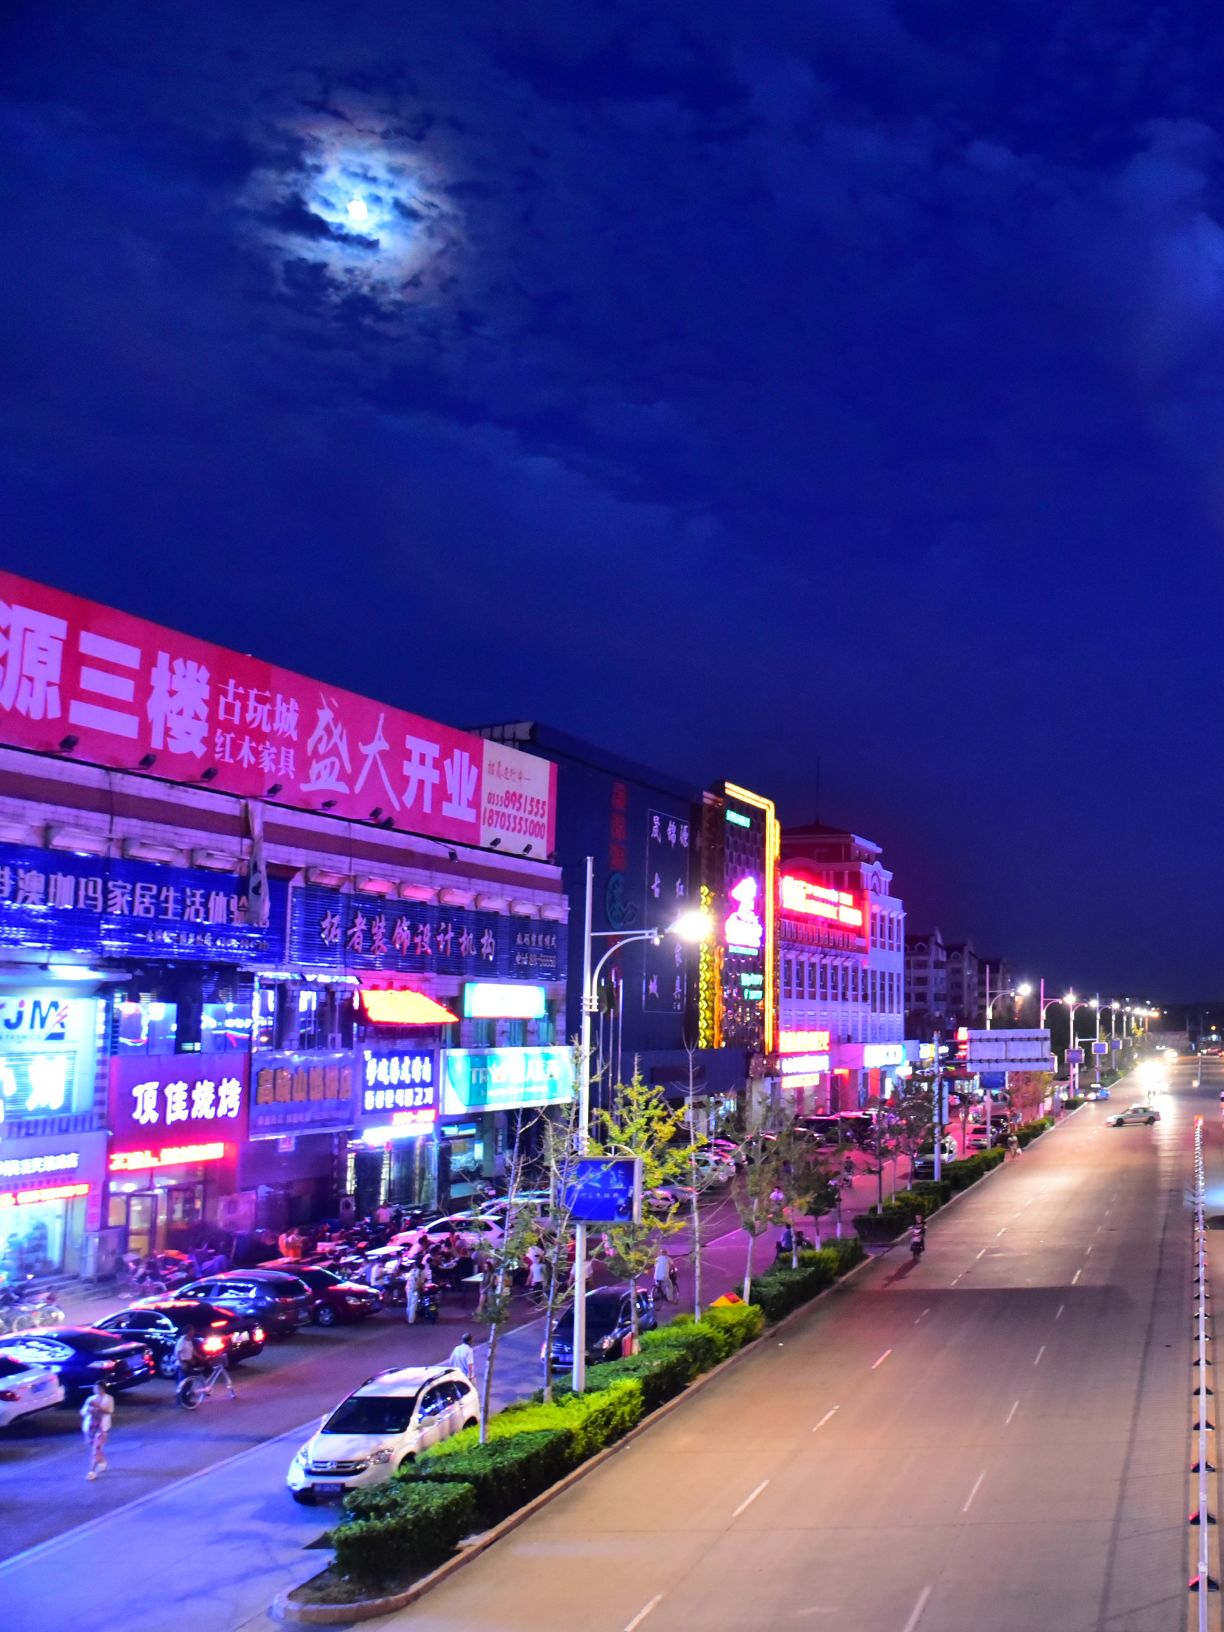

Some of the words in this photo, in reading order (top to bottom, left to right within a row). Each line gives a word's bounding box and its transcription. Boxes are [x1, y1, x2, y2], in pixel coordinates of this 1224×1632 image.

[217, 678, 299, 741] 古玩城
[213, 728, 297, 781] 红木家具
[300, 686, 480, 824] 盛大开业
[0, 865, 271, 929] 澳珈玛家居生活体验
[131, 1077, 243, 1125] 顶佳烧烤
